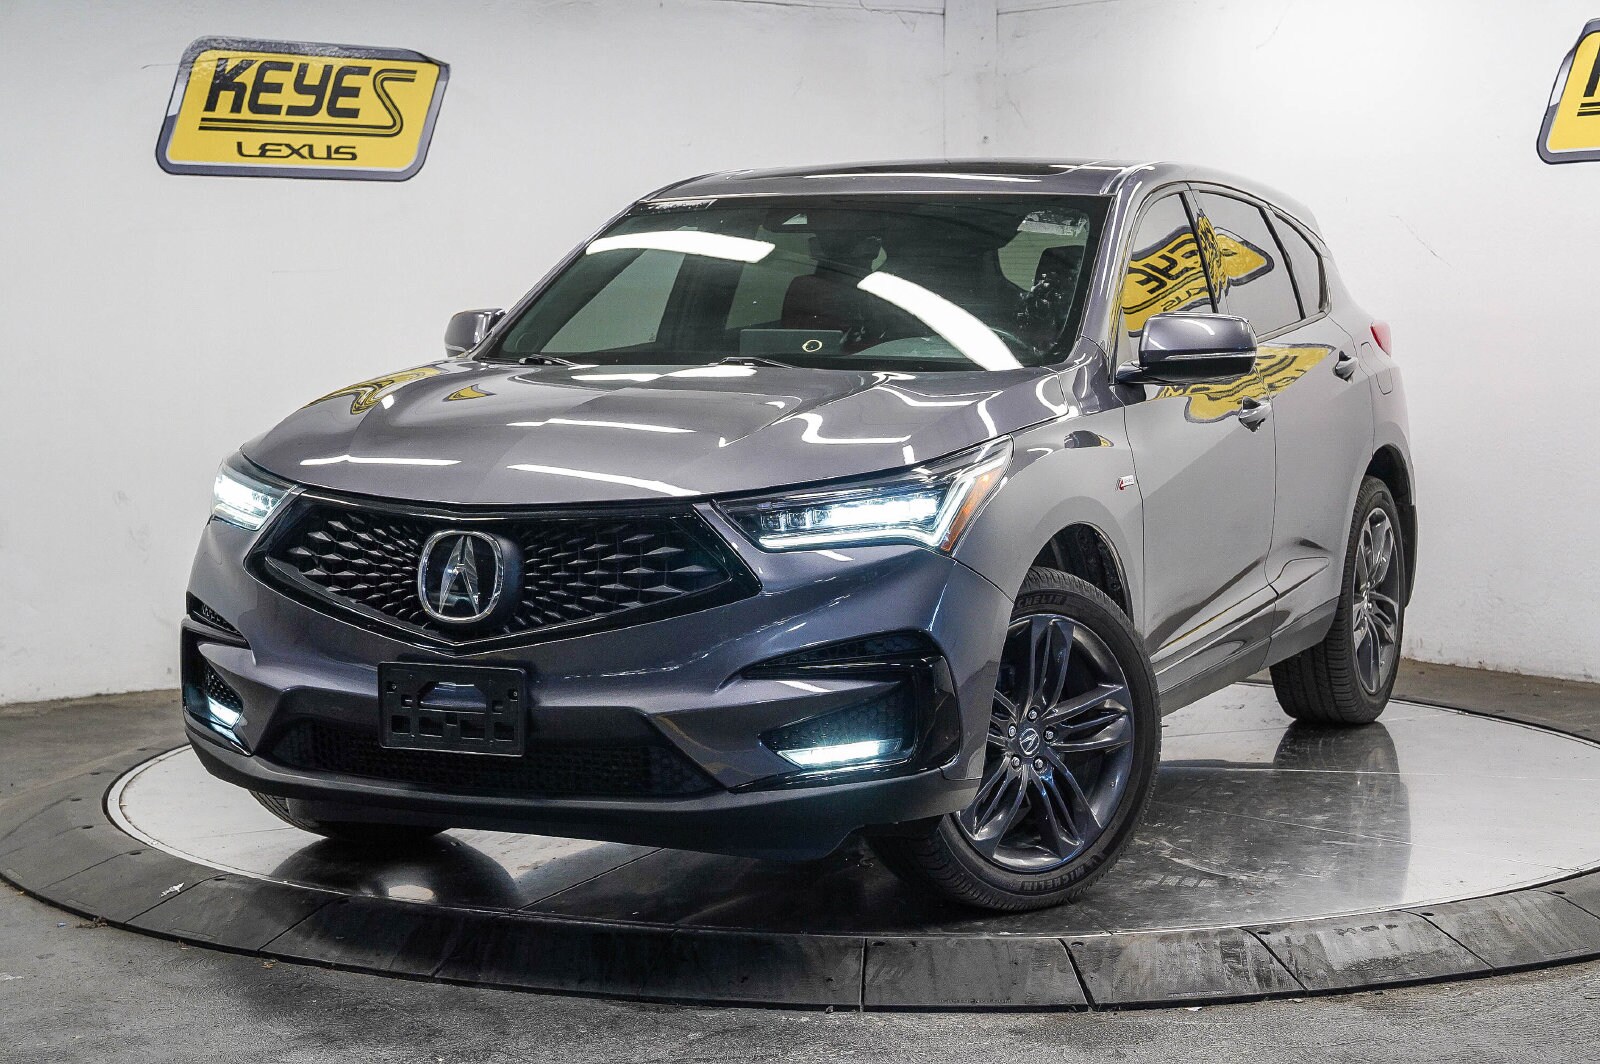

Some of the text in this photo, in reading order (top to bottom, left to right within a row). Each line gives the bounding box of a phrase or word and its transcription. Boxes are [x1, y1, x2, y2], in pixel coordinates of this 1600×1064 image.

[199, 57, 418, 137] KEYES
[236, 141, 358, 161] LEXUS
[1016, 594, 1064, 609] CHELIN
[1023, 865, 1086, 891] MICHELIN
